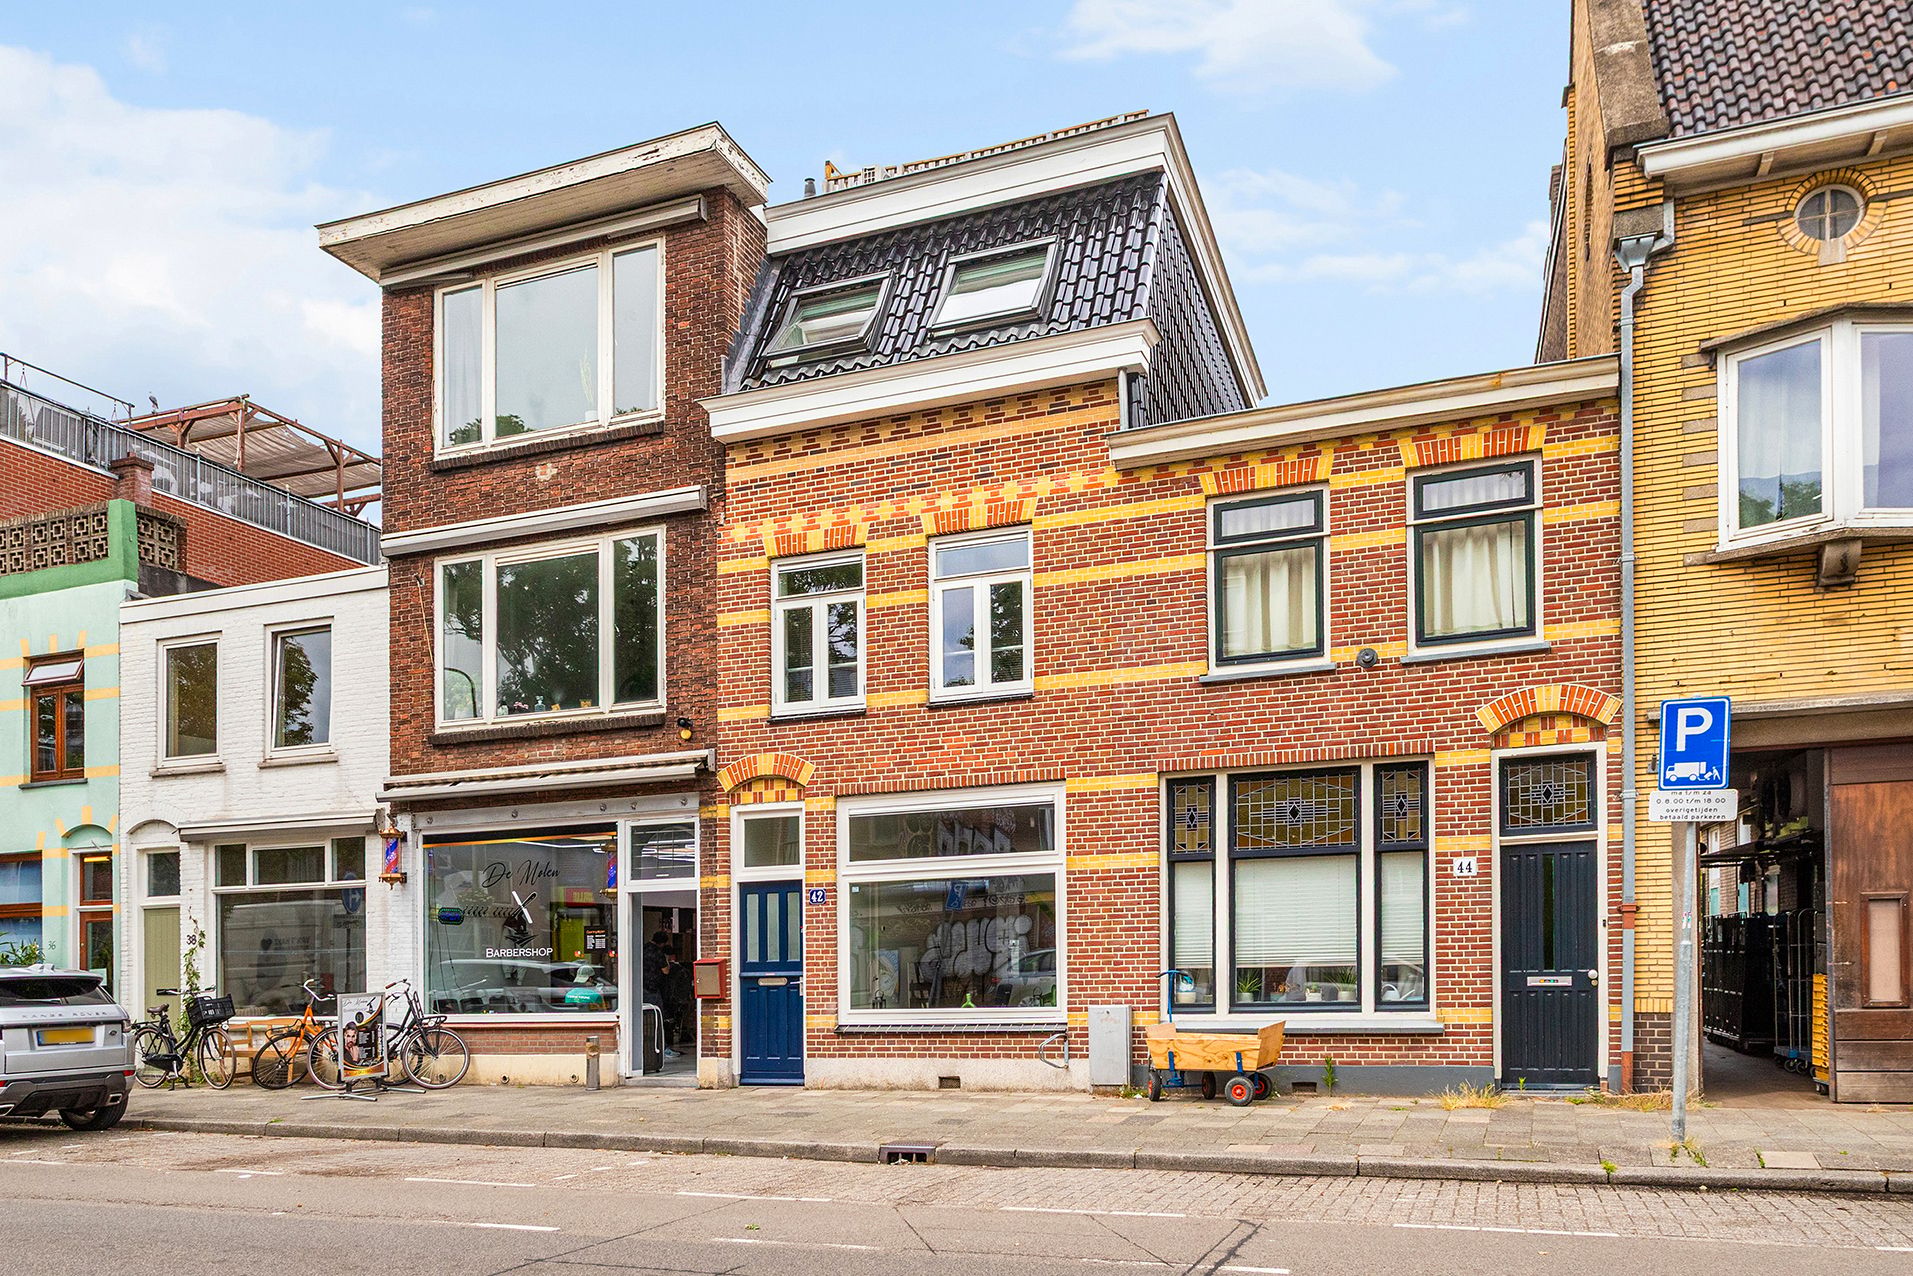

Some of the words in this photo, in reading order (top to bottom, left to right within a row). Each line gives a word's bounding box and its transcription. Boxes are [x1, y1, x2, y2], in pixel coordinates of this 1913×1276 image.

[1676, 707, 1713, 752] P
[1690, 813, 1726, 821] parkeren
[1457, 861, 1473, 873] 44
[482, 862, 512, 888] De
[517, 860, 560, 886] Molen
[811, 890, 824, 903] 42
[186, 934, 197, 945] 38
[485, 947, 554, 958] BARBERSHOP
